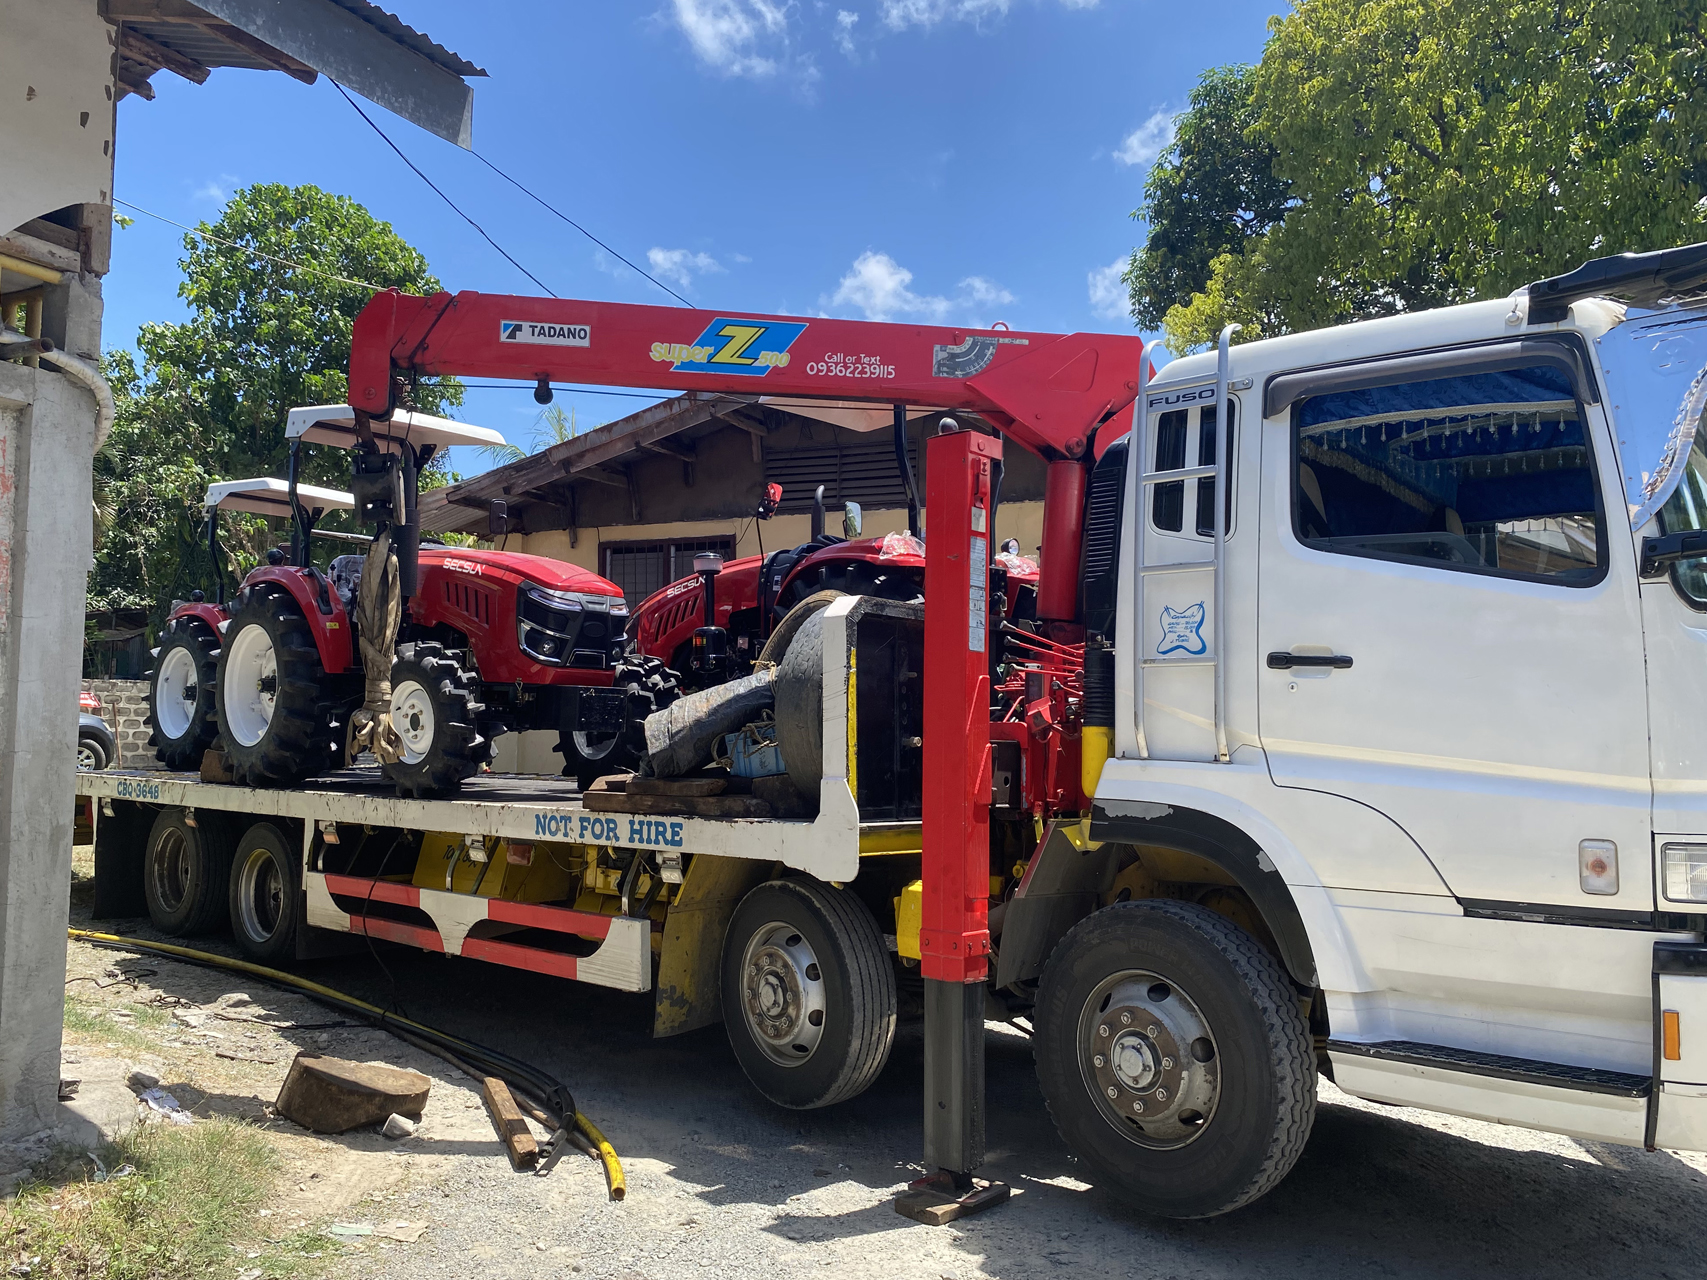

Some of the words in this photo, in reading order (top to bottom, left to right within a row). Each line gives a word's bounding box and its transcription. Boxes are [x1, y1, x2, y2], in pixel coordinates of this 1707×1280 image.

[529, 324, 588, 340] TADANO
[650, 342, 714, 363] super
[709, 324, 769, 366] Z
[758, 352, 791, 368] 500
[825, 352, 844, 364] Call
[846, 354, 857, 364] or
[860, 354, 881, 365] Text
[806, 362, 896, 379] 09362239115
[1149, 388, 1216, 409] FUSO
[443, 557, 486, 576] SECSUN
[135, 782, 160, 800] 3648
[534, 813, 573, 838] NOT
[578, 816, 620, 843] FOR
[628, 819, 684, 847] HIRE
